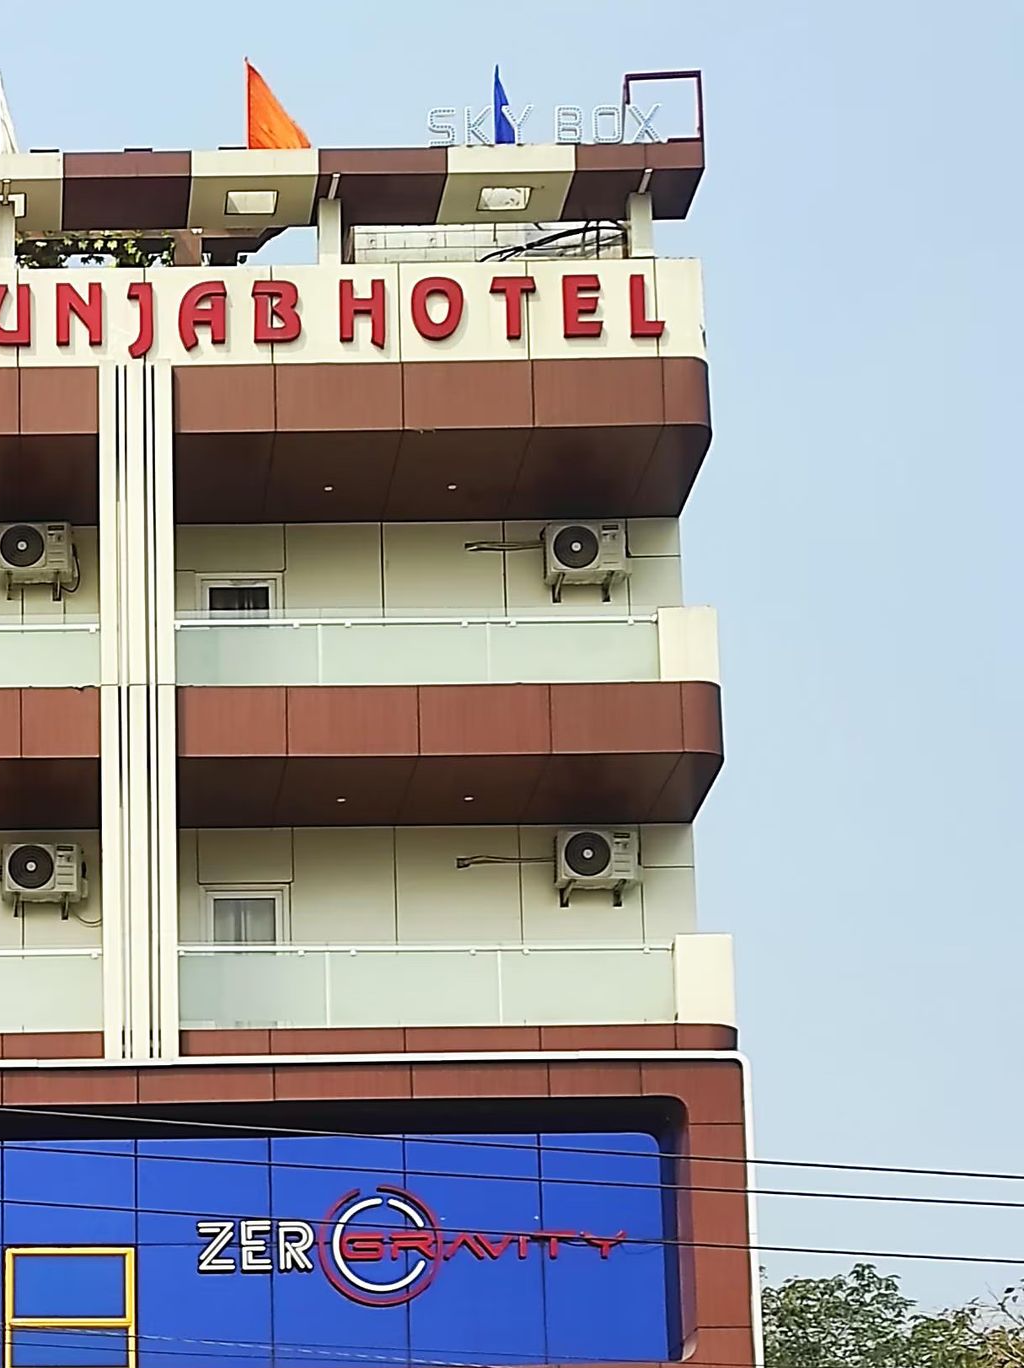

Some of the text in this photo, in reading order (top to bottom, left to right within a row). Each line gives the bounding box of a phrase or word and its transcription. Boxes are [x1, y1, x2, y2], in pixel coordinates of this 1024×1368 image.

[427, 103, 662, 147] SKY BOX
[338, 273, 666, 350] HOTEL
[339, 1228, 628, 1263] GRAVITY
